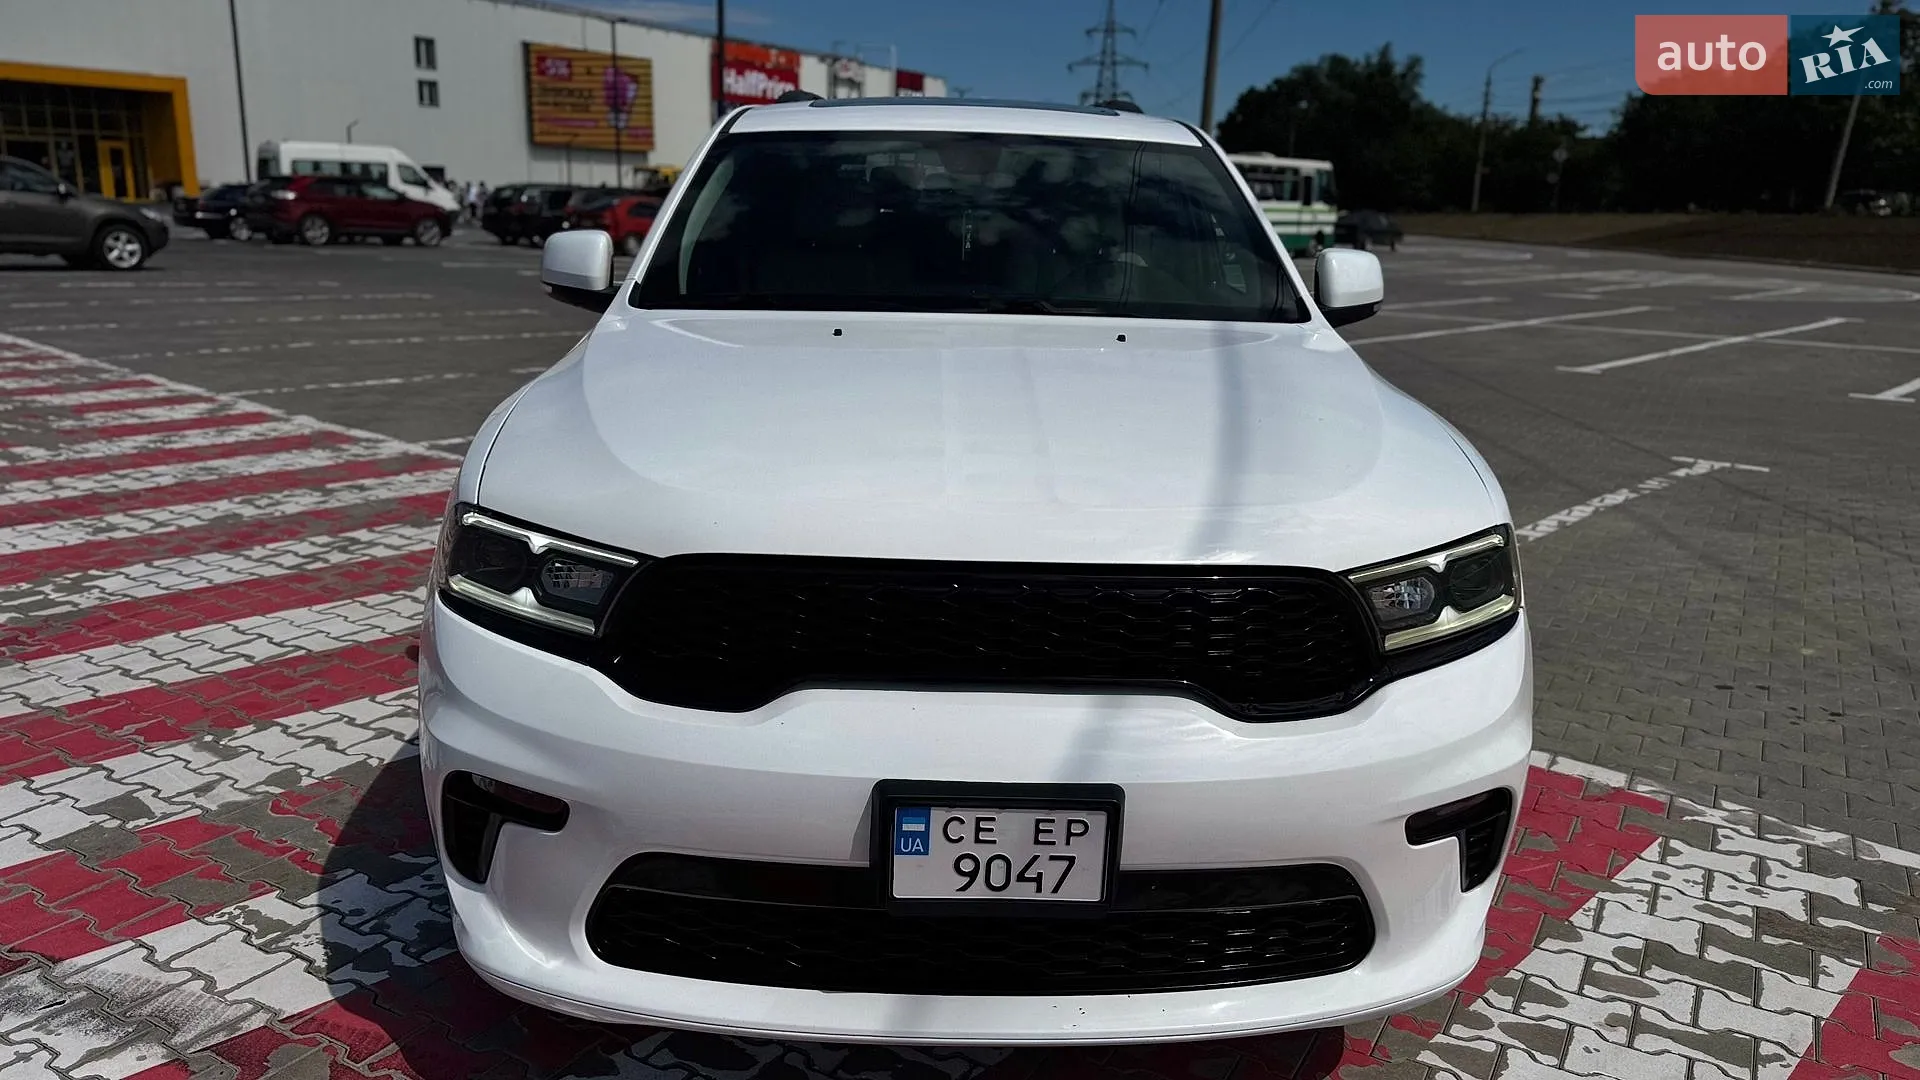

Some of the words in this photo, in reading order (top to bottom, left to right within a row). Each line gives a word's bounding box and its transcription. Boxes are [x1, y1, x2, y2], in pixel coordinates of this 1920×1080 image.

[901, 837, 924, 853] UA
[942, 815, 997, 844] CE
[1033, 817, 1090, 846] EP
[953, 852, 1077, 894] 9047
